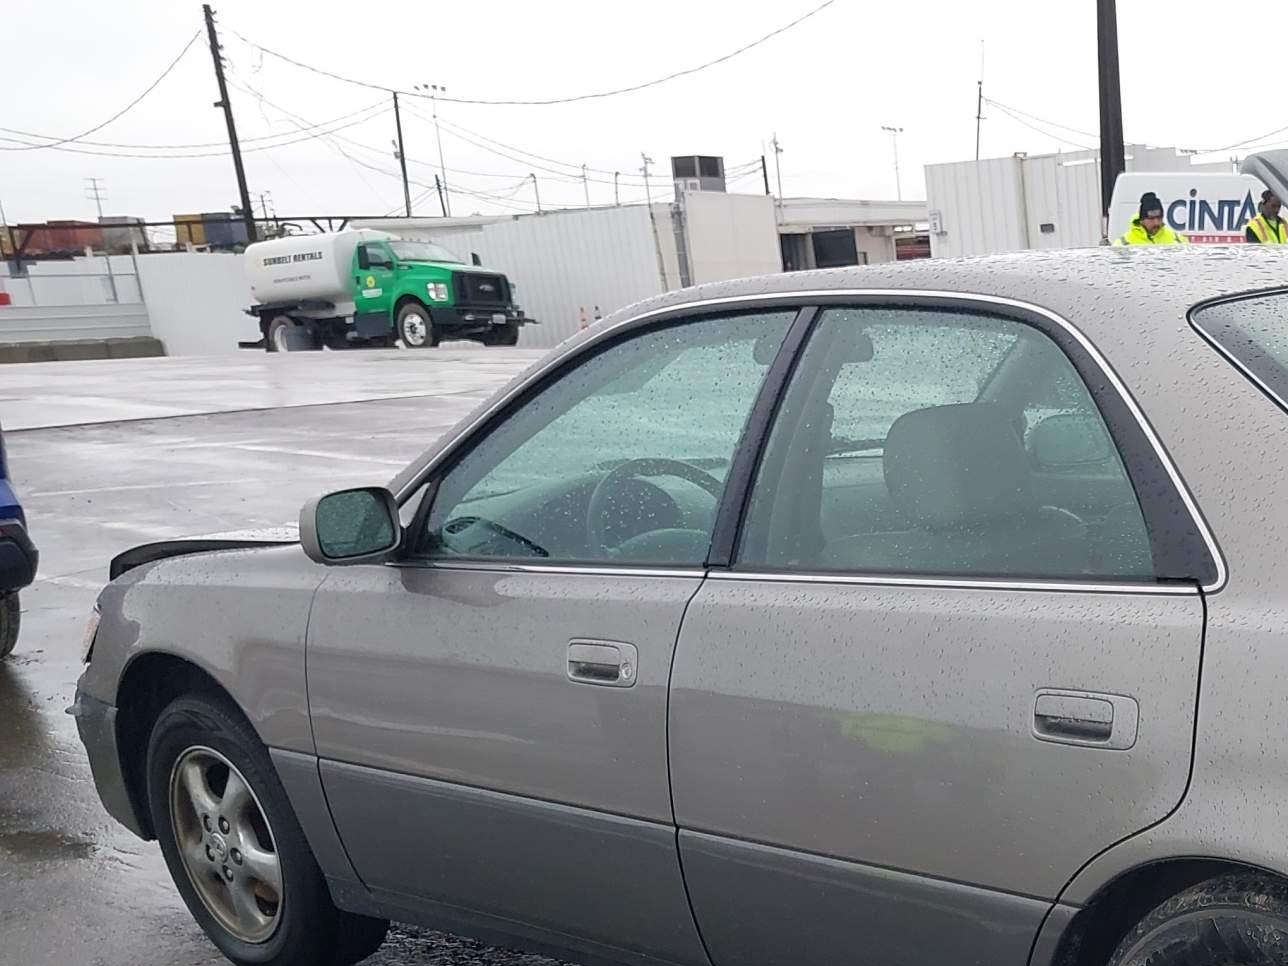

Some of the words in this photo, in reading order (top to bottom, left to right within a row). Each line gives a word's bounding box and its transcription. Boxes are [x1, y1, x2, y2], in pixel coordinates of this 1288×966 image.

[1167, 188, 1264, 231] CINTA
[263, 255, 291, 266] SUNBELT
[293, 251, 323, 263] RENTALS
